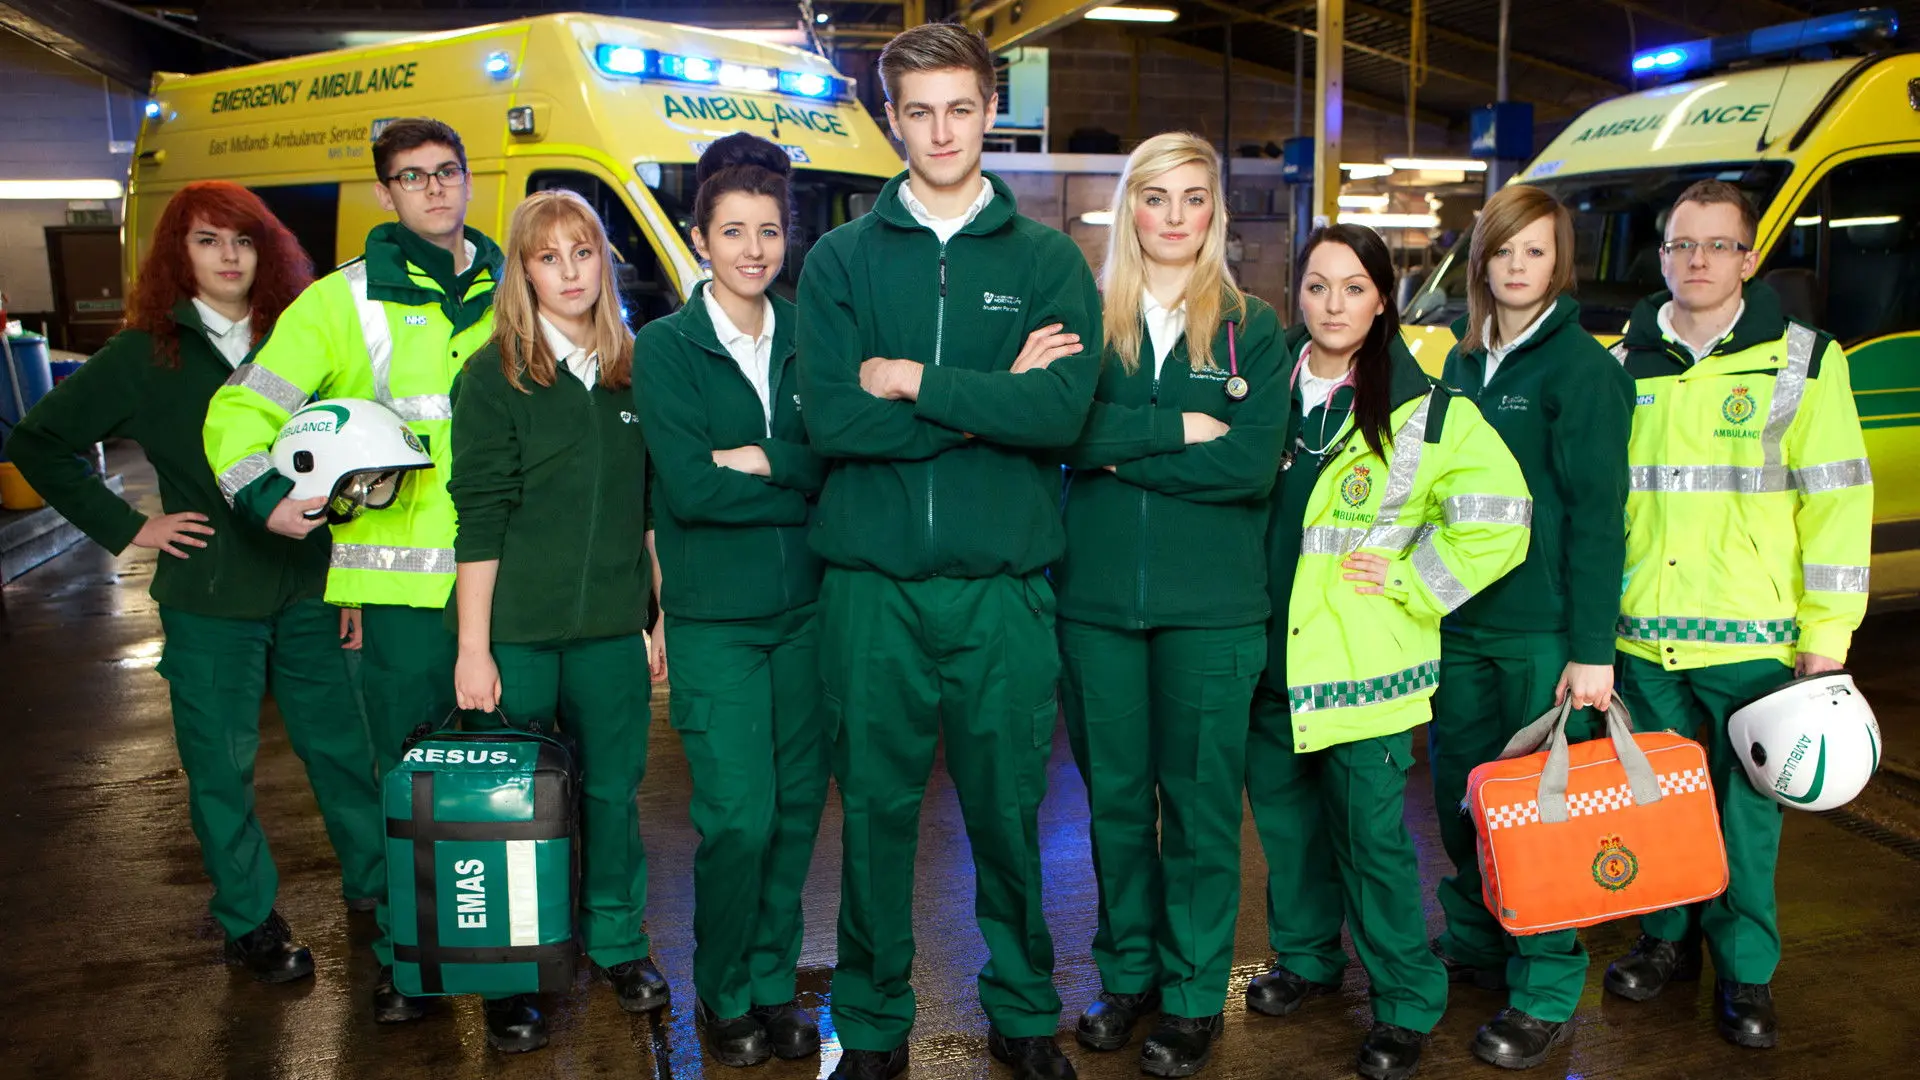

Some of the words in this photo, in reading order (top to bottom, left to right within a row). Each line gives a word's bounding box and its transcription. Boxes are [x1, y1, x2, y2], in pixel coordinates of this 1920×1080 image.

[211, 80, 302, 114] EMERGENCY
[307, 62, 418, 101] AMBULANCE
[272, 128, 326, 149] Ambulance
[329, 125, 368, 144] Service
[664, 94, 849, 137] AMBULANCE
[405, 315, 427, 325] NHS
[403, 747, 517, 765] RESUS.
[1775, 732, 1812, 791] AMBULANCE
[454, 859, 487, 929] EMAS
